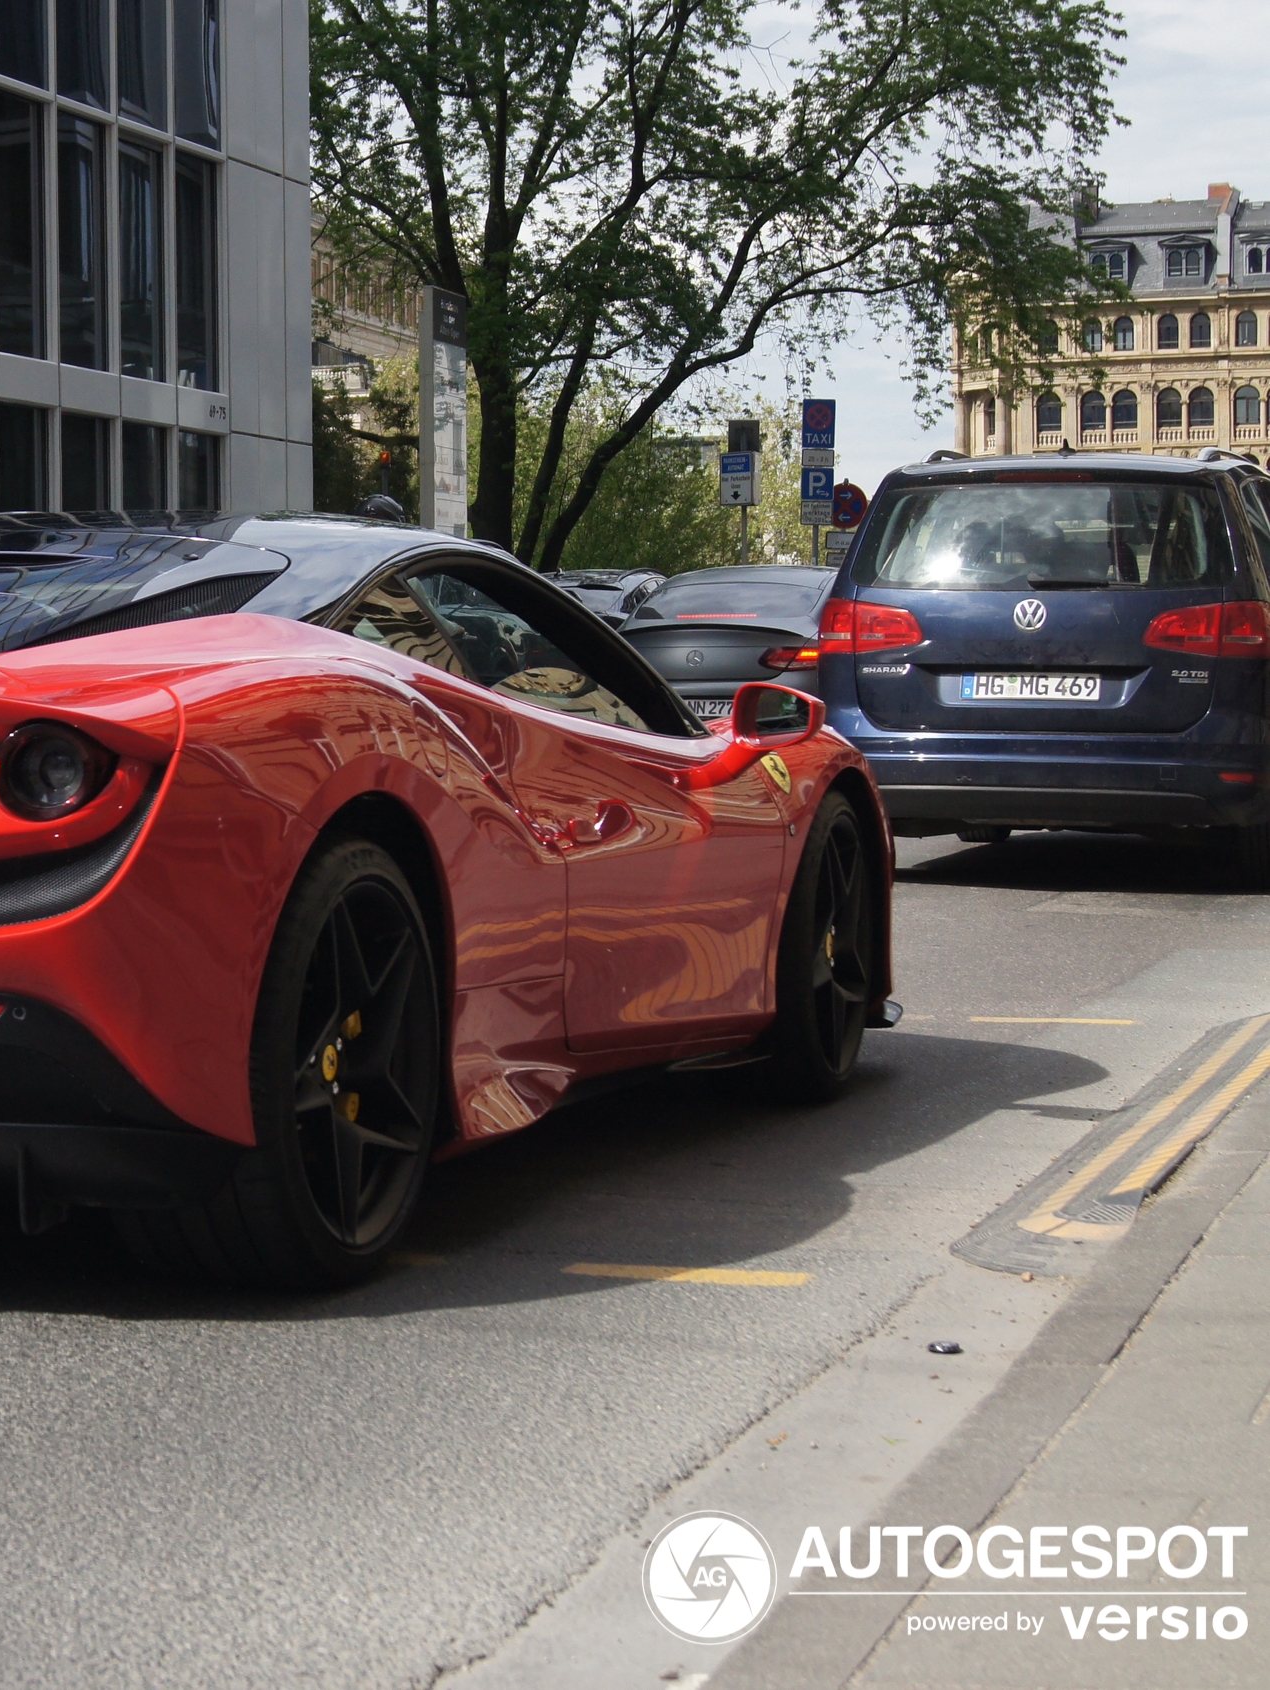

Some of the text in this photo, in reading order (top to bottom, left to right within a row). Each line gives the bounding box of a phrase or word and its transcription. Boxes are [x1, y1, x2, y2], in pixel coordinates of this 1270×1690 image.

[805, 433, 832, 445] TAXI
[808, 472, 827, 497] P
[862, 666, 904, 674] SHARAN
[1190, 670, 1209, 678] TDI
[975, 675, 1098, 697] HG MG 469
